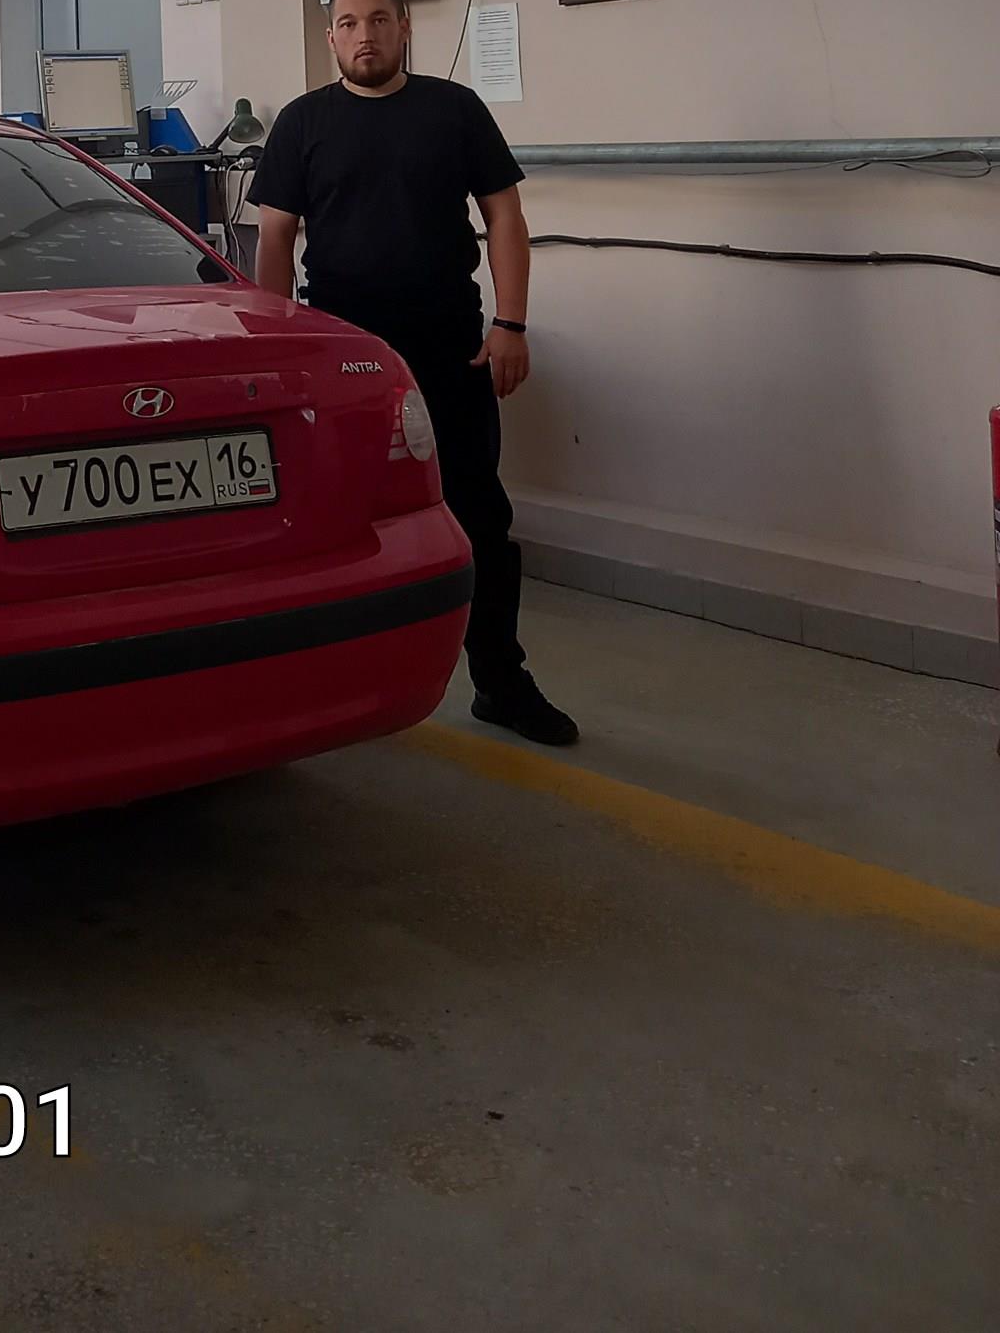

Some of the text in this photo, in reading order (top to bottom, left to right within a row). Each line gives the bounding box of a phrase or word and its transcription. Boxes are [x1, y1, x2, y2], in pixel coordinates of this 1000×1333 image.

[341, 361, 384, 373] ANTRA
[216, 441, 257, 481] 16
[217, 482, 249, 499] RUS
